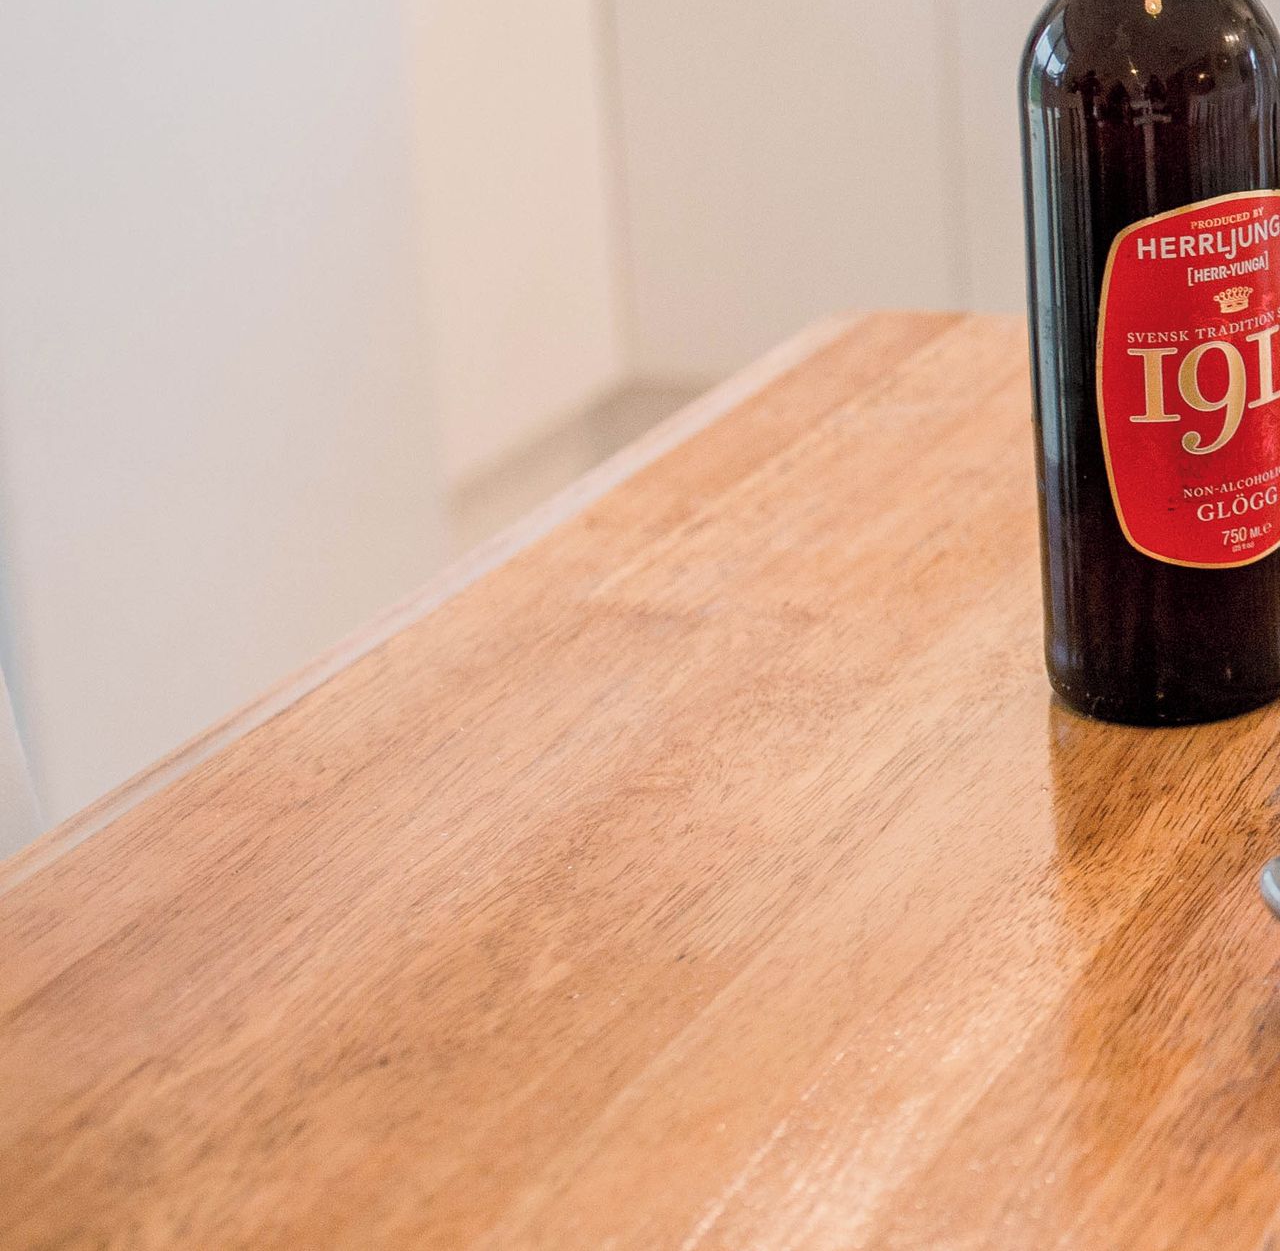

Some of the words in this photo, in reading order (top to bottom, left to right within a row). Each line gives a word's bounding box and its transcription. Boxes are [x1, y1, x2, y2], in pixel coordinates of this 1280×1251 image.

[1190, 211, 1250, 230] PRODUCED
[1252, 206, 1265, 219] BY
[1187, 250, 1269, 287] [HERR-YUNGA]
[1127, 330, 1190, 344] SVENSK
[1195, 310, 1276, 340] TRADITION
[1197, 486, 1278, 521] GLÖGG
[1221, 526, 1247, 546] 750
